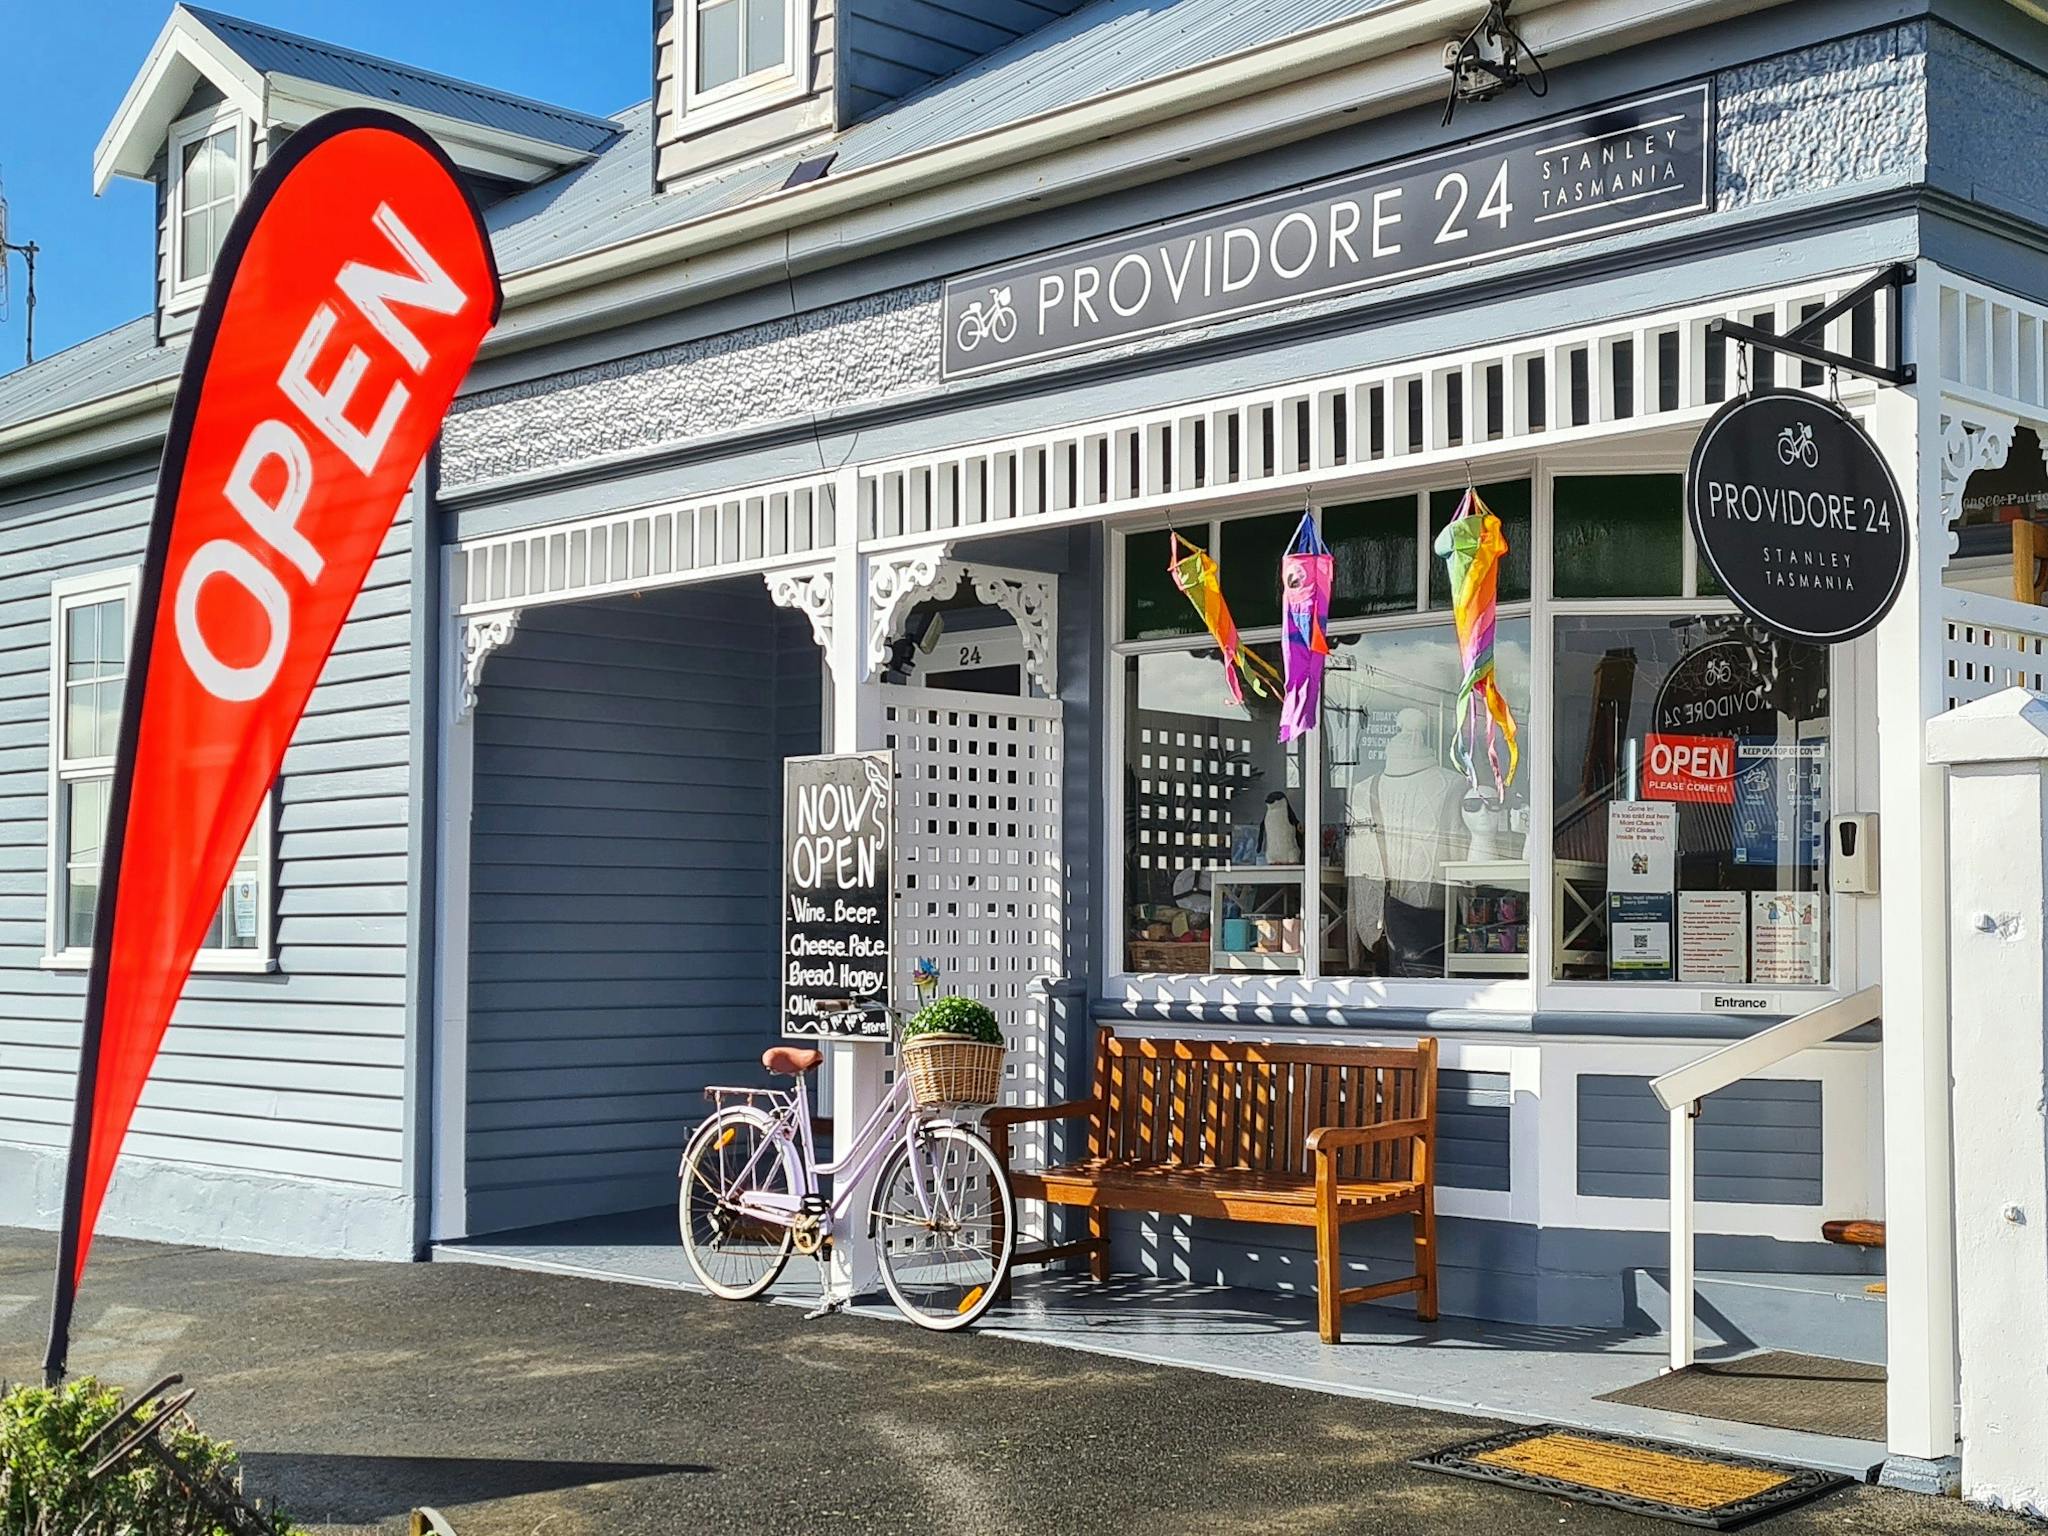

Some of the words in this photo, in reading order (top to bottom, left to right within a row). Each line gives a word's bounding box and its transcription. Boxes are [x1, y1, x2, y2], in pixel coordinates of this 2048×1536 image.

[1542, 129, 1676, 180] STANLEY
[1542, 161, 1676, 209] TASMANIA
[1038, 187, 1403, 336] PROVIDORE
[1433, 158, 1513, 244] 24
[174, 200, 468, 702] OPEN
[1708, 481, 1857, 531] PROVIDORE
[1863, 497, 1891, 534] 24
[1763, 546, 1851, 569] STANLEY
[1765, 570, 1855, 592] TASMANIA
[959, 645, 982, 666] 24
[1650, 743, 1729, 778] OPEN
[797, 783, 872, 835] NOW
[1648, 780, 1685, 791] PLEASE
[1686, 782, 1715, 793] COME
[1717, 785, 1728, 794] IN
[792, 834, 876, 890] OPEN
[1714, 996, 1767, 1008] Entrance
